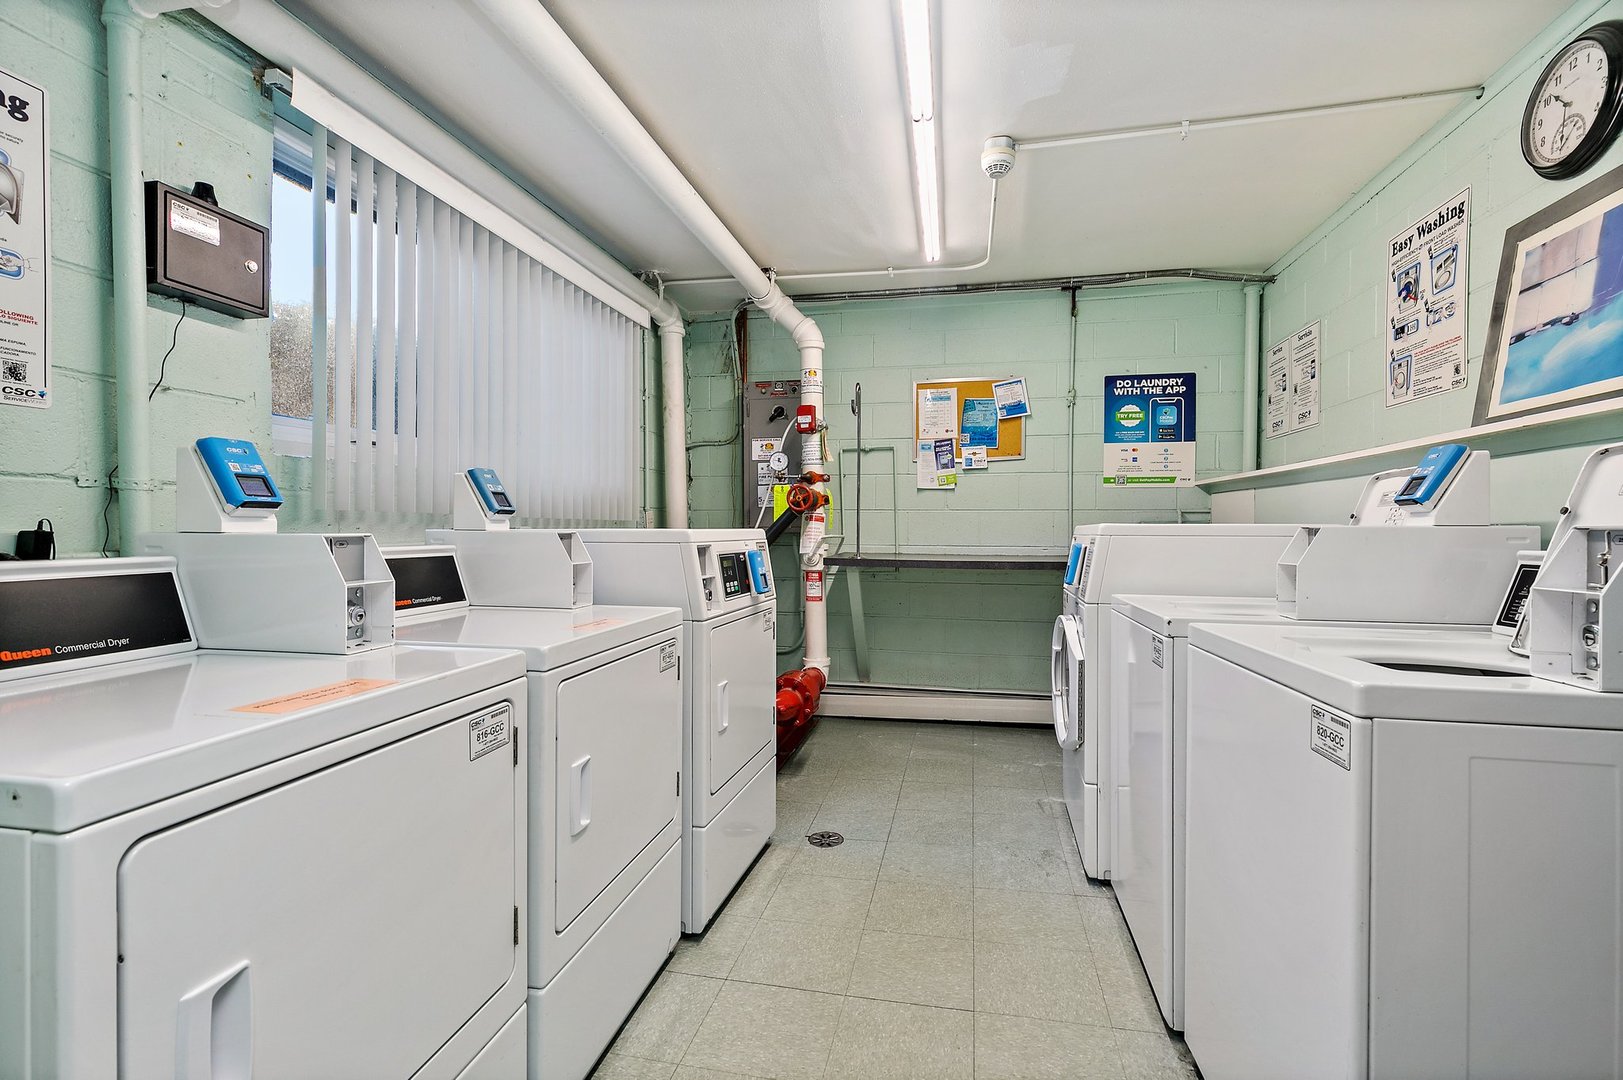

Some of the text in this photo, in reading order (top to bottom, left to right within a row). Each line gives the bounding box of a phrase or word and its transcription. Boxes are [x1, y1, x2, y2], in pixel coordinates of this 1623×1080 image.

[1568, 56, 1578, 72] 12
[1596, 59, 1603, 72] 2
[1554, 74, 1562, 87] 11
[1542, 95, 1551, 109] 10
[1537, 118, 1543, 130] 9
[1540, 136, 1546, 148] 8
[1391, 234, 1415, 258] Easy
[1416, 201, 1465, 241] Washing
[1436, 229, 1447, 241] LOAD
[1447, 218, 1465, 233] WASHER
[1116, 378, 1184, 388] DO LAUNDRY
[1451, 378, 1462, 387] CSC
[2, 386, 36, 398] CSC
[1113, 386, 1187, 396] WITH THE APP
[412, 597, 432, 605] Commercial
[0, 637, 131, 662] Queen Commercial Dryer
[476, 722, 505, 742] 816-GCC
[1316, 725, 1345, 748] 820-GCC
